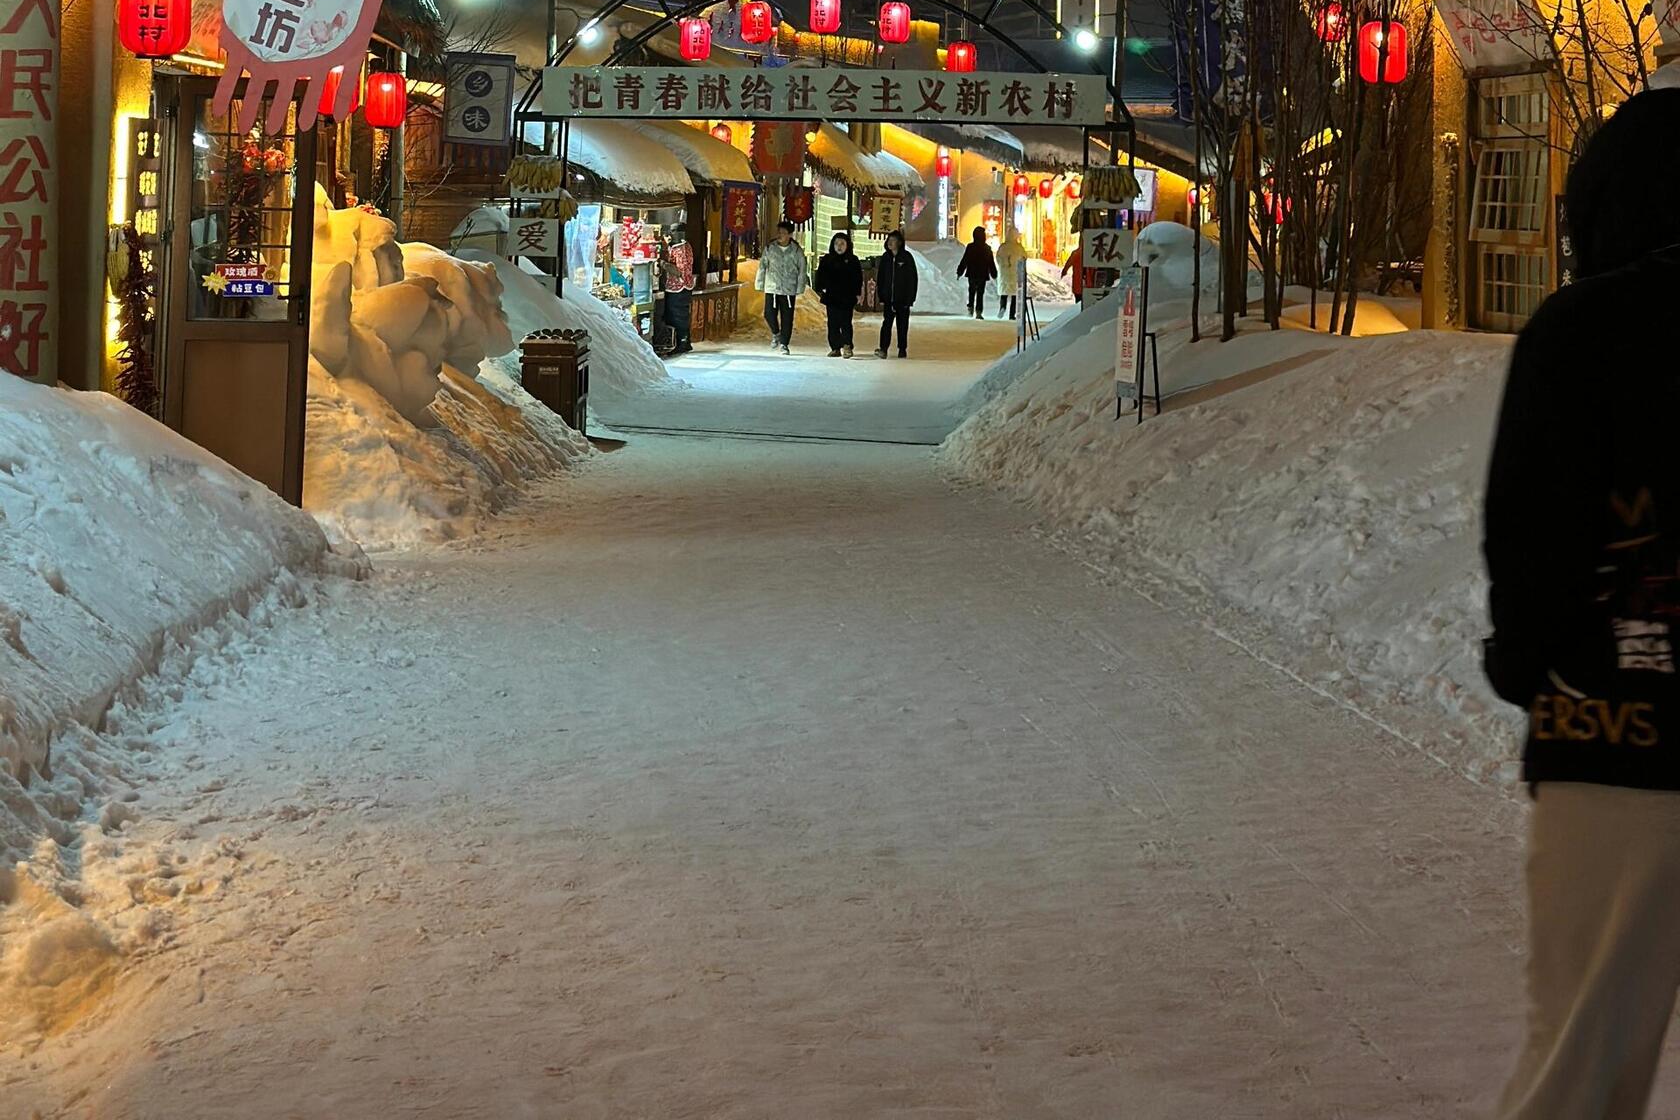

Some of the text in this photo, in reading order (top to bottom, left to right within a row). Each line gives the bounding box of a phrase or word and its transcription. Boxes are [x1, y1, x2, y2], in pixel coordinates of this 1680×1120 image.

[464, 73, 490, 130] 乡味
[567, 72, 1078, 118] 把青春献给社会主义新农村
[517, 220, 549, 253] 爱
[1091, 231, 1124, 263] 私
